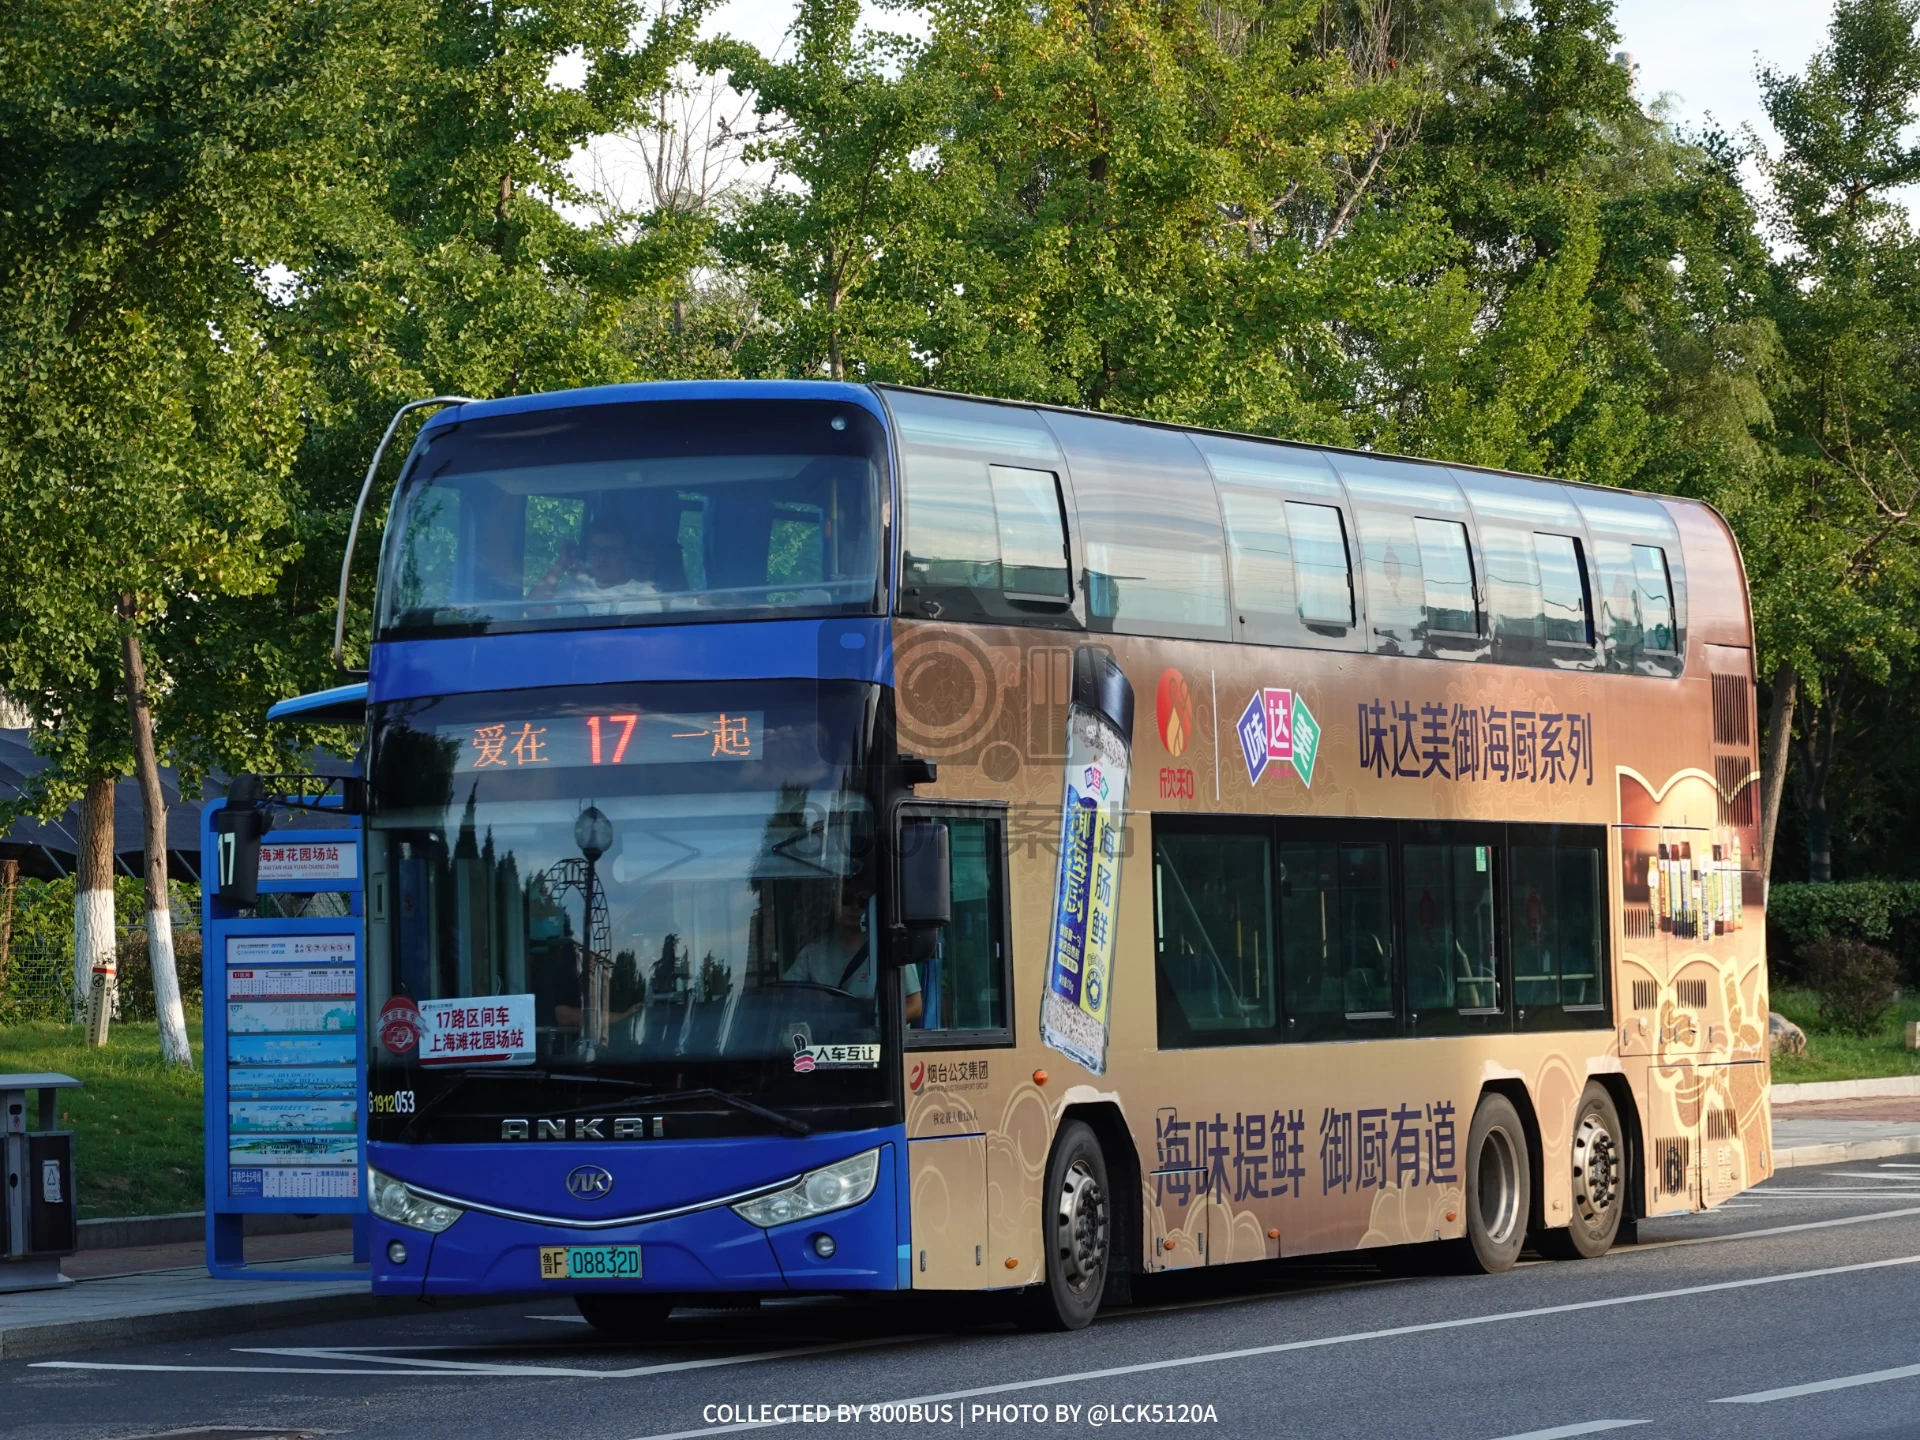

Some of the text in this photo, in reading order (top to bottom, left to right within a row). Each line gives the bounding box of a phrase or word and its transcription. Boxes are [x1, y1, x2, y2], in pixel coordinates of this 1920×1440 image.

[473, 714, 751, 767] 爱在 17 一起
[1357, 697, 1594, 787] 味达美御海厨系列
[217, 832, 236, 887] 17
[259, 846, 339, 862] 海滩花园场站
[436, 1006, 510, 1029] 17路区间车
[430, 1029, 524, 1052] 上海滩花园场站
[816, 1046, 875, 1061] 人车互让
[927, 1060, 988, 1083] 烟台公交集团
[502, 1117, 664, 1139] ANKAI
[1155, 1100, 1458, 1207] 海味提鲜 御厨有道
